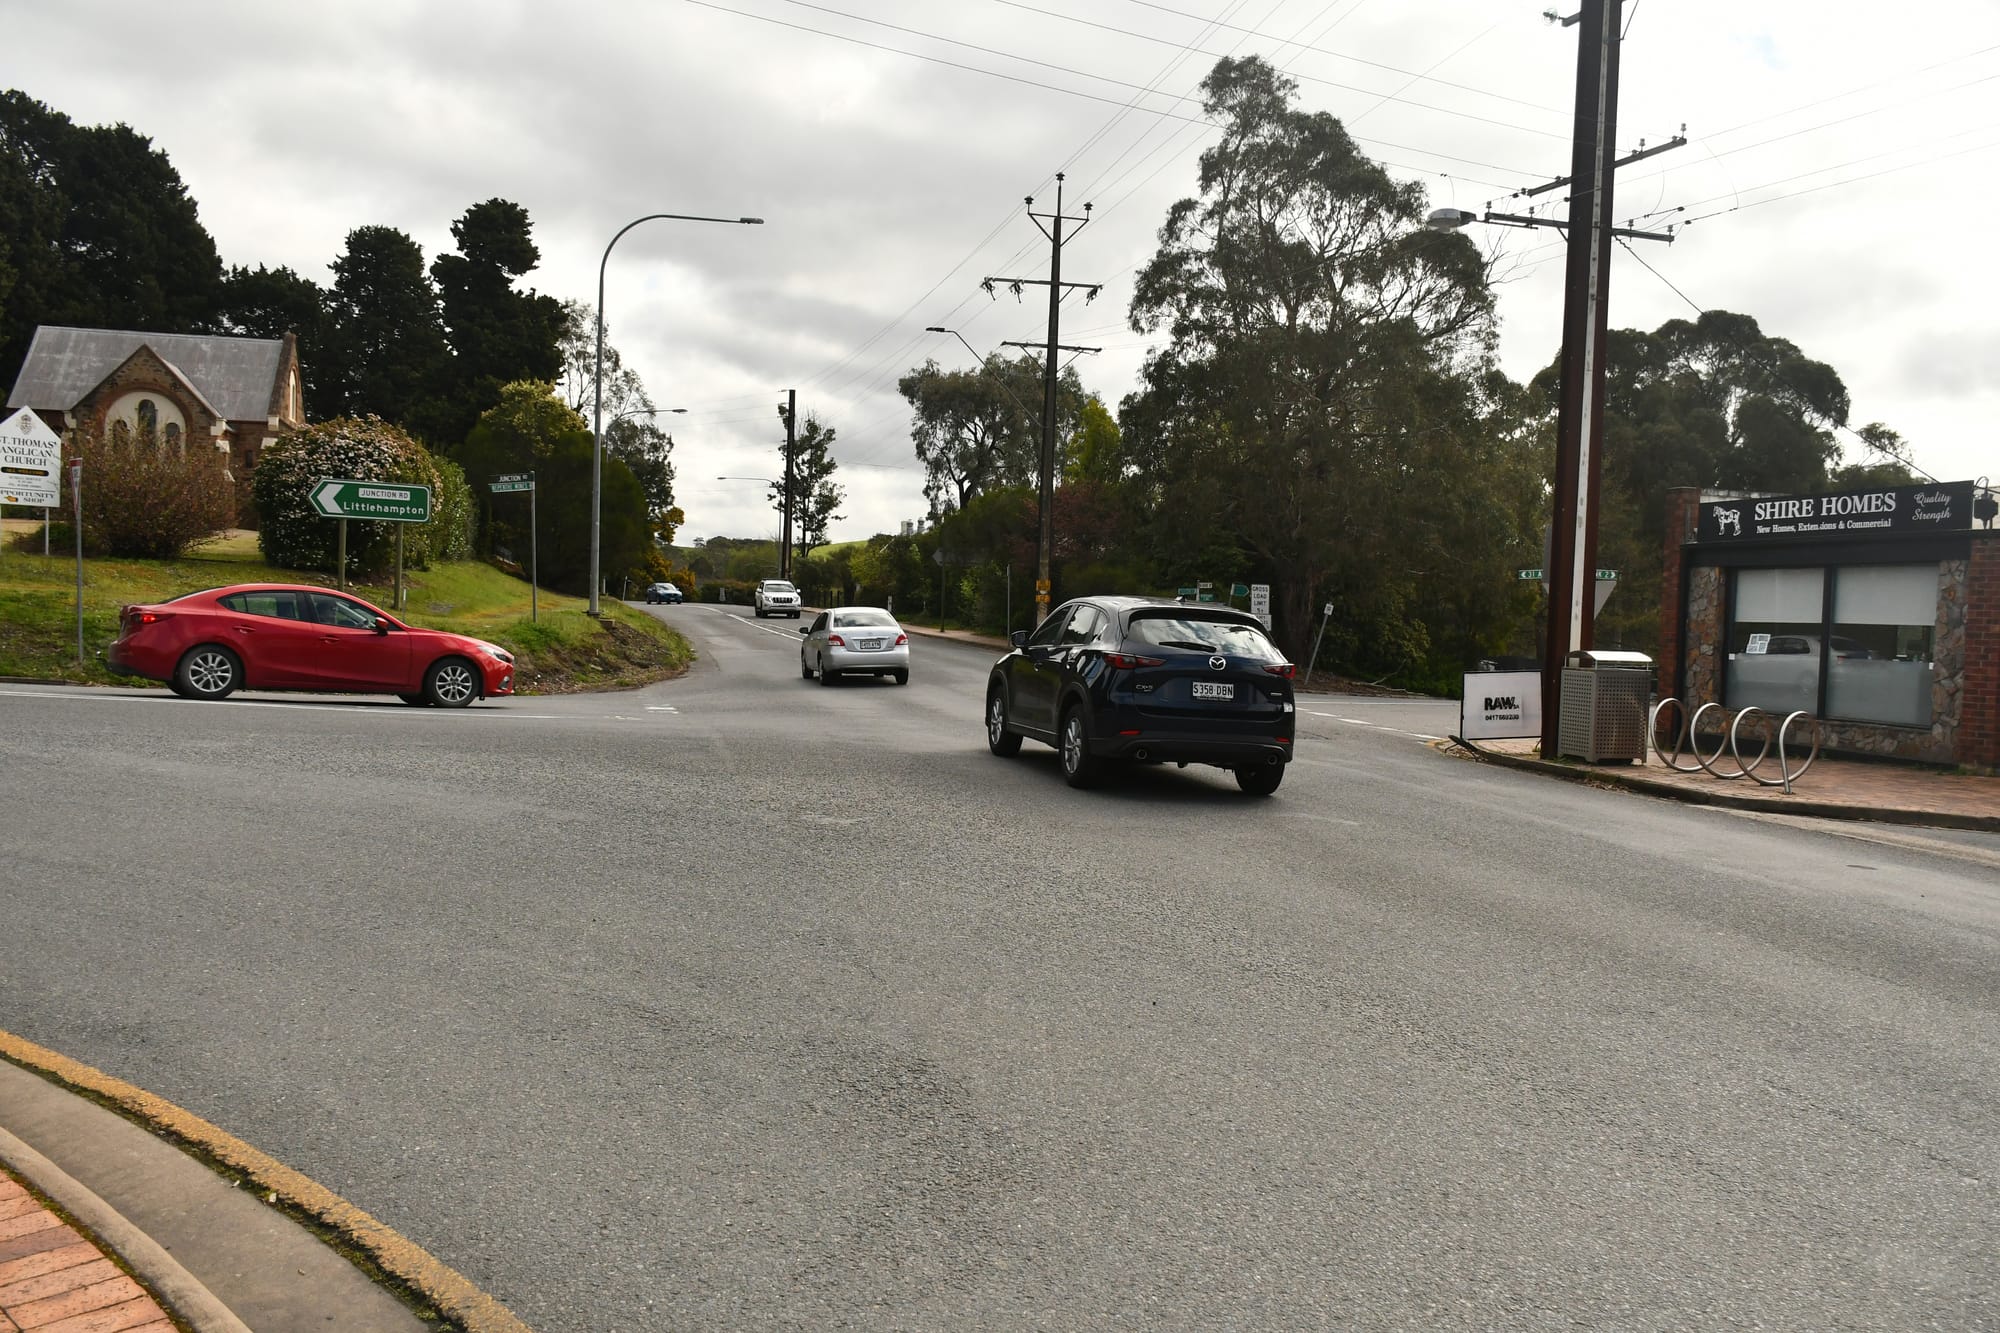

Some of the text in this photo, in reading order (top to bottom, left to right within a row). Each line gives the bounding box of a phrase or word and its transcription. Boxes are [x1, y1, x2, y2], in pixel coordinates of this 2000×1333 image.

[11, 437, 57, 449] THOMAS'
[1, 446, 52, 457] ANGLICAN
[4, 455, 47, 467] CHURCH
[0, 489, 54, 499] PPORTUNITY
[361, 490, 398, 498] JUNCTION
[1914, 491, 1951, 507] Quality
[343, 502, 425, 515] Littlehampton
[1754, 492, 1897, 520] SHIRE HOMES
[1912, 507, 1951, 523] Strength
[1756, 525, 1771, 534] New
[1772, 524, 1797, 533] Homes,
[1838, 521, 1846, 530] &
[1847, 518, 1891, 529] Commercial
[1484, 697, 1515, 711] RAW
